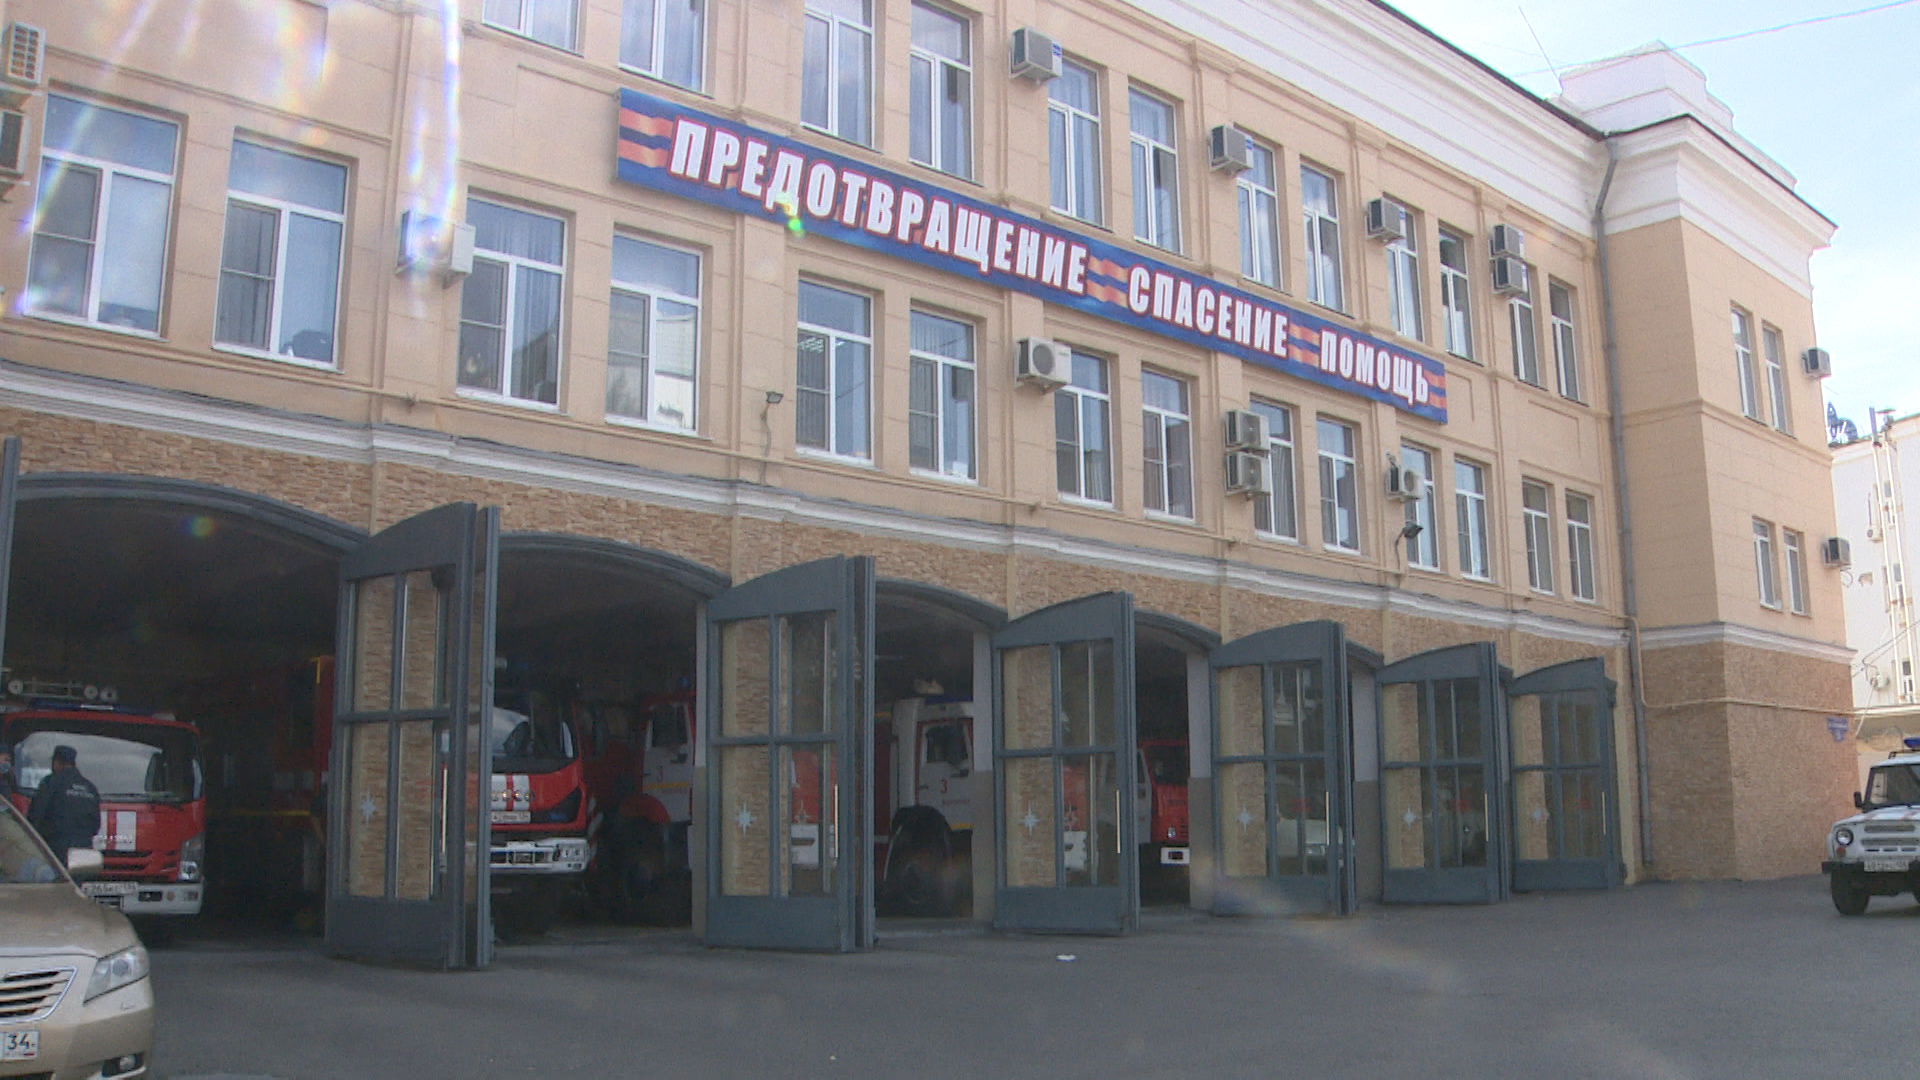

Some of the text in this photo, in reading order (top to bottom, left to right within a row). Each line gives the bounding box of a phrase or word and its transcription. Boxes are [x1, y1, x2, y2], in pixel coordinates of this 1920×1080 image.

[670, 120, 1429, 405] ПРЕДОТВРАЩЕНИЕ СПАСЕНИЕ ПОМОЩЬ
[7, 1033, 29, 1050] 34
